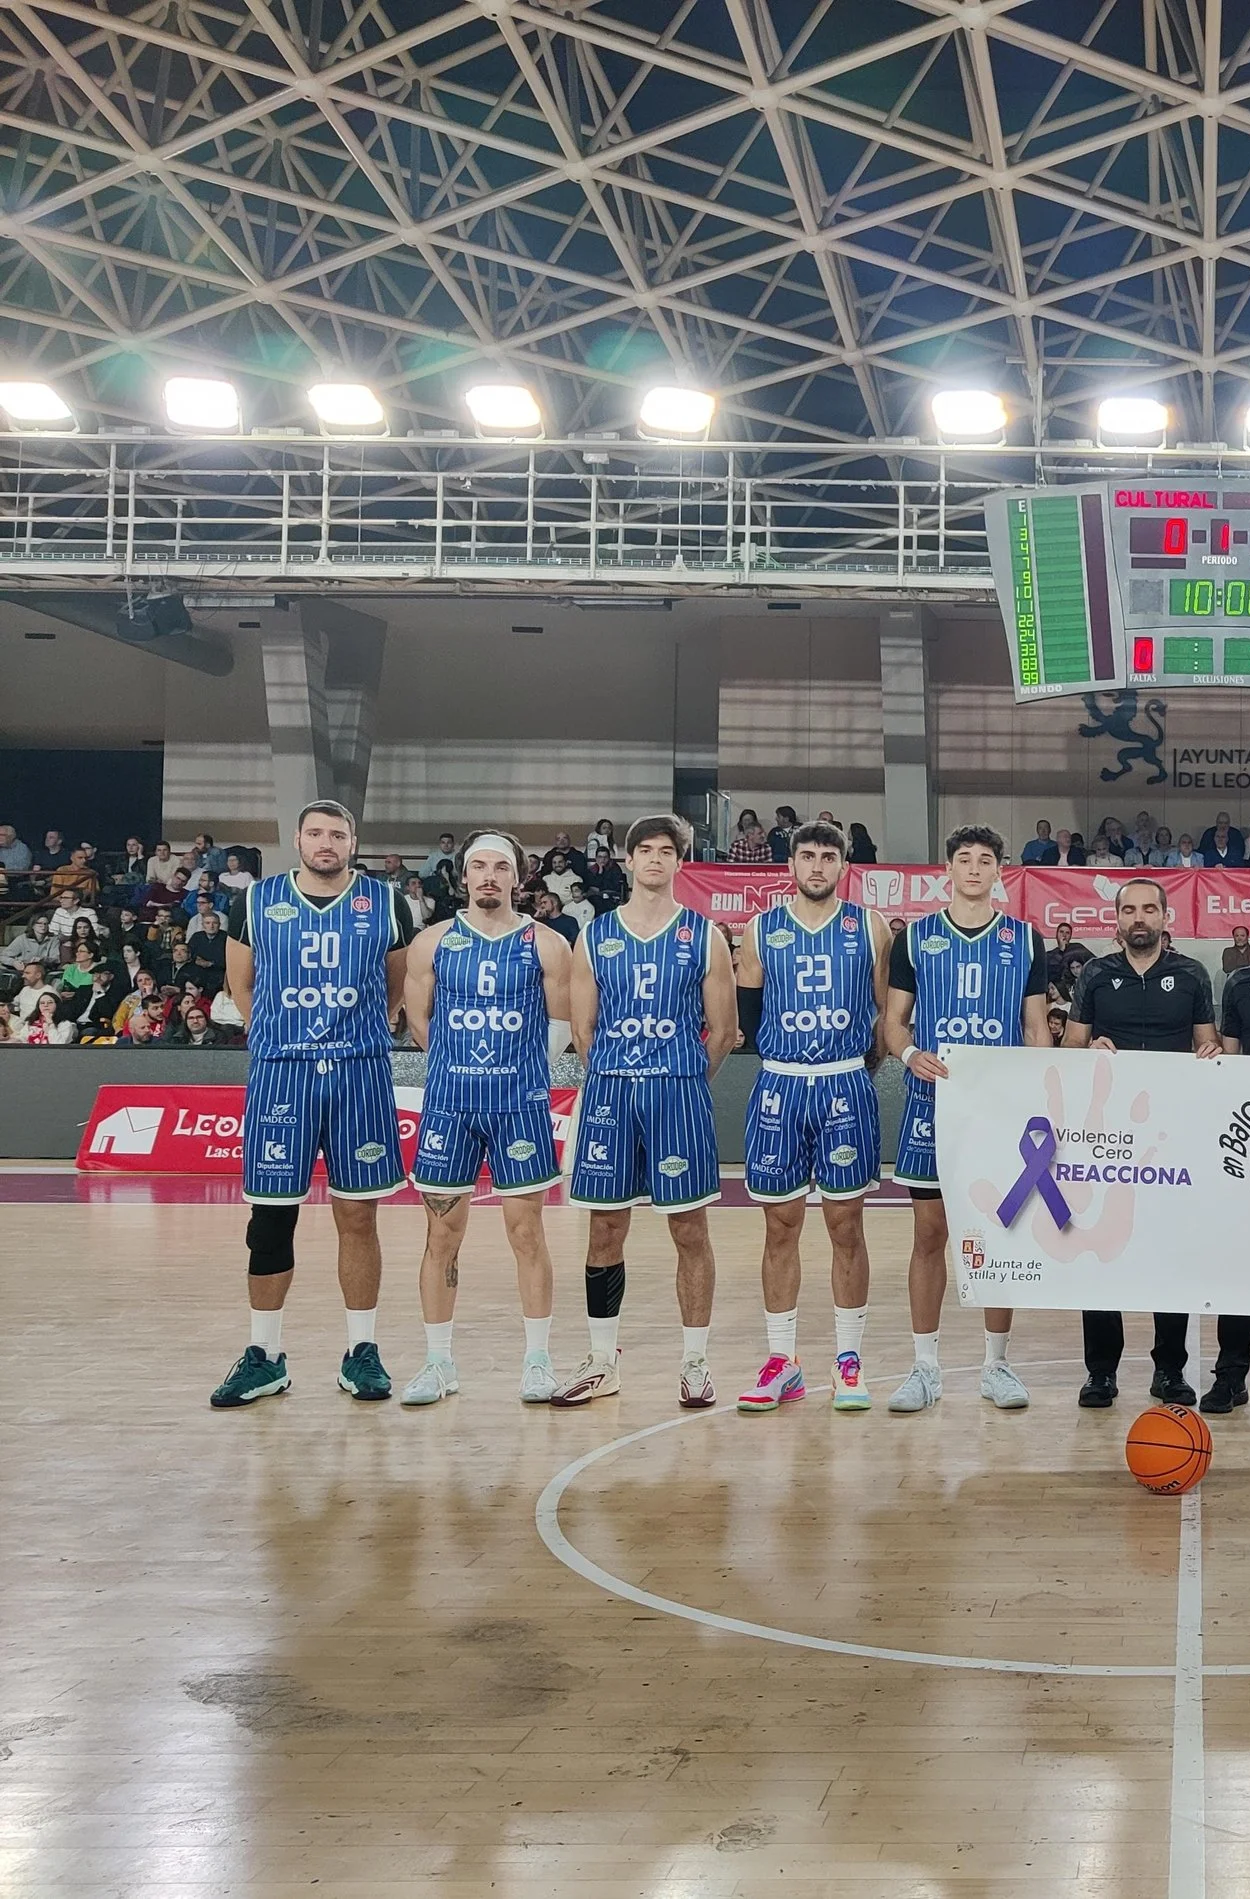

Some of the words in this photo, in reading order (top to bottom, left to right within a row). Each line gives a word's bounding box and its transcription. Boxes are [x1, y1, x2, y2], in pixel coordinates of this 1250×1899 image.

[1018, 500, 1026, 512] E
[1115, 491, 1215, 509] CULTURAL
[1020, 528, 1028, 541] 3
[1164, 518, 1187, 555] 0
[1221, 523, 1230, 551] 1
[1020, 543, 1029, 555] 4
[1022, 557, 1030, 569] 7
[1201, 556, 1238, 565] PERIODO
[1022, 571, 1031, 584] 9
[1016, 586, 1032, 599] 10
[1017, 601, 1033, 612] 11
[1018, 614, 1034, 628] 22
[1019, 629, 1035, 642] 24
[1020, 643, 1037, 657] 33
[1134, 639, 1153, 671] 0
[1021, 657, 1038, 671] 83
[1022, 671, 1039, 685] 99
[1129, 674, 1157, 683] FALTAS
[1193, 675, 1244, 684] EXCLUSIONES
[1020, 684, 1063, 695] MONDO
[1178, 772, 1205, 788] DE
[711, 893, 743, 911] BUN
[301, 931, 340, 969] 20
[477, 960, 497, 997] 6
[796, 954, 832, 992] 23
[633, 963, 657, 1000] 12
[957, 963, 982, 999] 10
[281, 982, 358, 1009] coto
[448, 1006, 523, 1032] coto
[781, 1005, 851, 1032] coto
[606, 1014, 676, 1039] coto
[935, 1013, 1003, 1040] coto
[280, 1041, 353, 1051] ATRESVEGA
[449, 1066, 518, 1075] ATRESVEGA
[260, 1115, 297, 1124] IMDECO
[586, 1115, 616, 1126] IMDECO
[1056, 1127, 1134, 1145] Violencia
[205, 1145, 231, 1158] Las
[1092, 1145, 1133, 1160] Cero
[257, 1162, 294, 1171] Diputación
[581, 1161, 613, 1171] Diputación
[751, 1162, 783, 1175] IMDECO
[1222, 1155, 1245, 1179] en
[266, 1169, 294, 1177] Córdoba
[587, 1169, 613, 1177] Córdoba
[1055, 1163, 1192, 1186] REACCIONA
[987, 1258, 1022, 1270] Junta
[1026, 1259, 1042, 1270] de
[999, 1272, 1007, 1283] y
[1011, 1270, 1041, 1282] León
